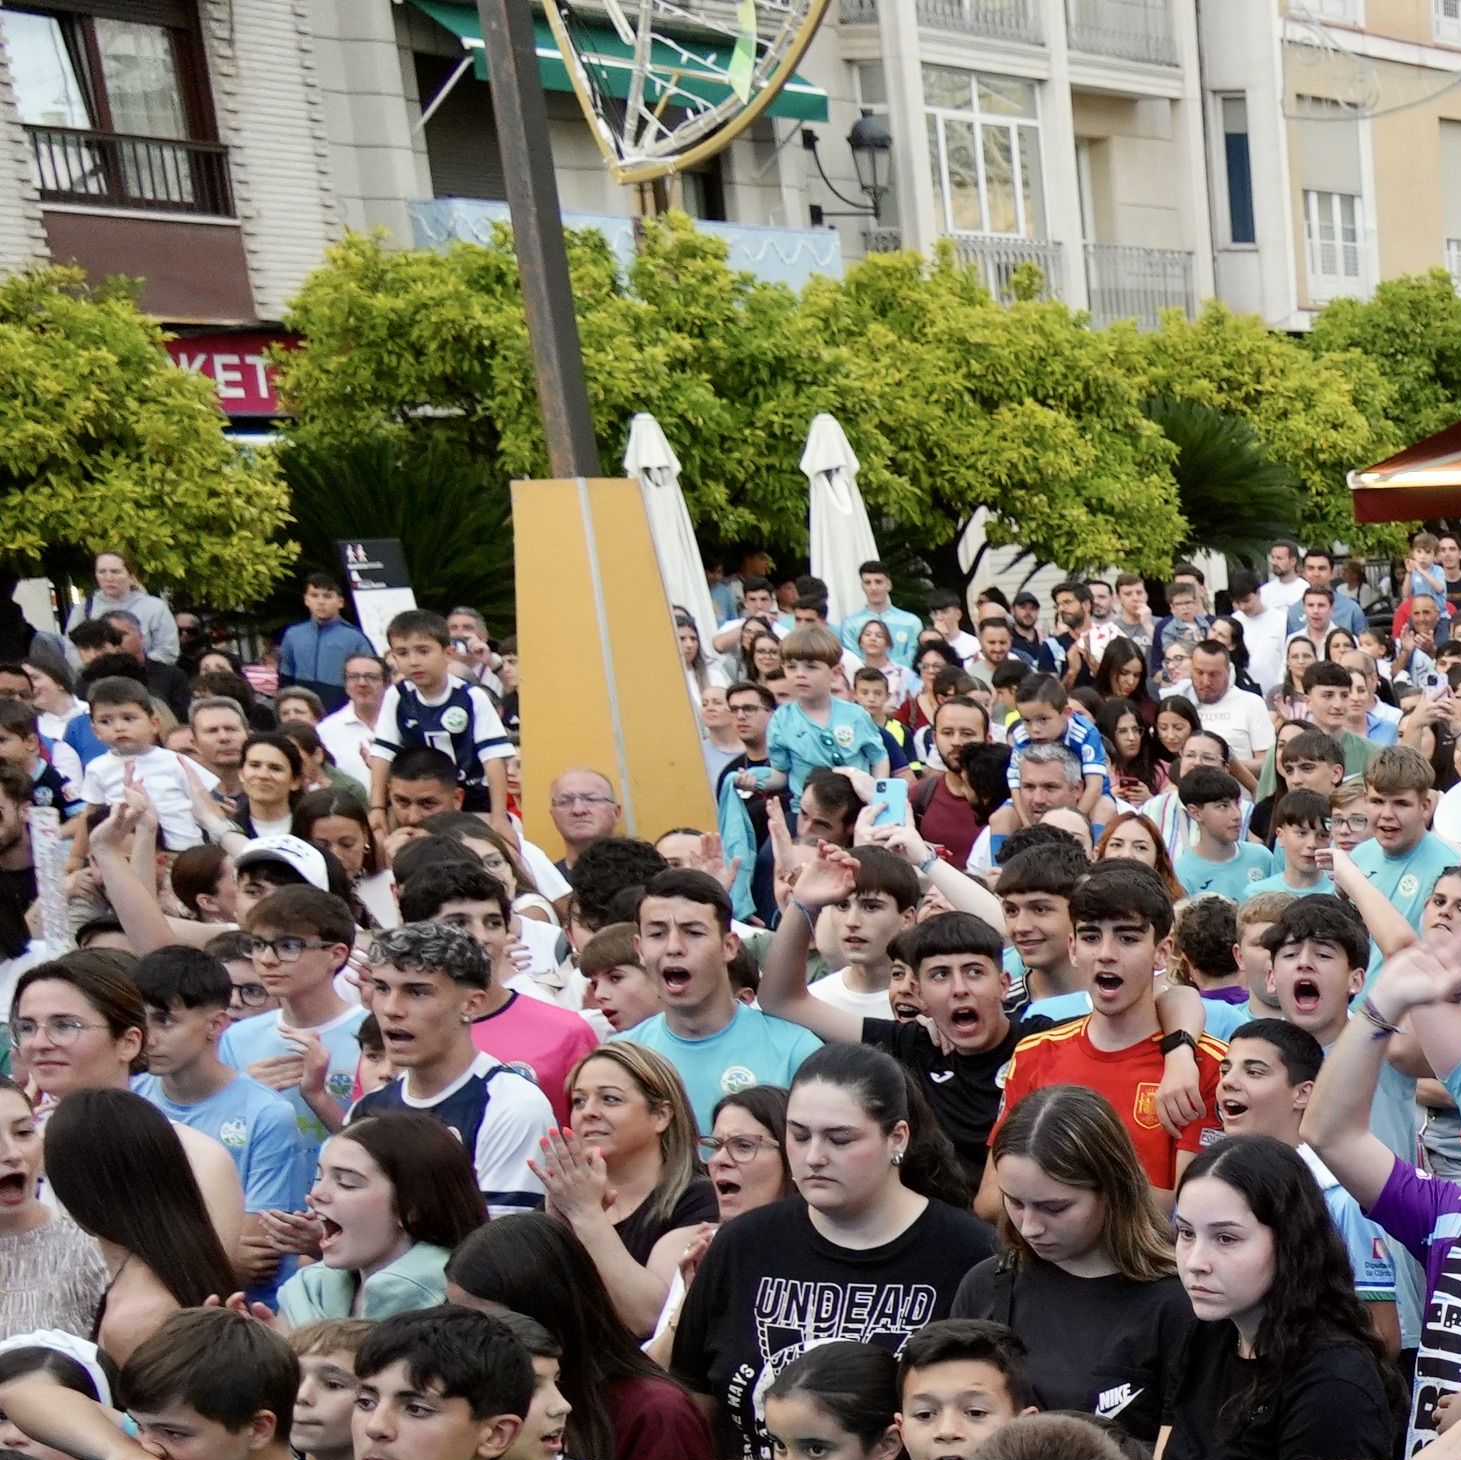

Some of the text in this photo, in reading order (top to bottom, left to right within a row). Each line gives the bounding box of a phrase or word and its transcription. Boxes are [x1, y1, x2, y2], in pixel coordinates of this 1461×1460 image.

[168, 352, 275, 400] KET
[752, 1276, 936, 1331] UNDEAD
[1098, 1382, 1131, 1411] NIKE
